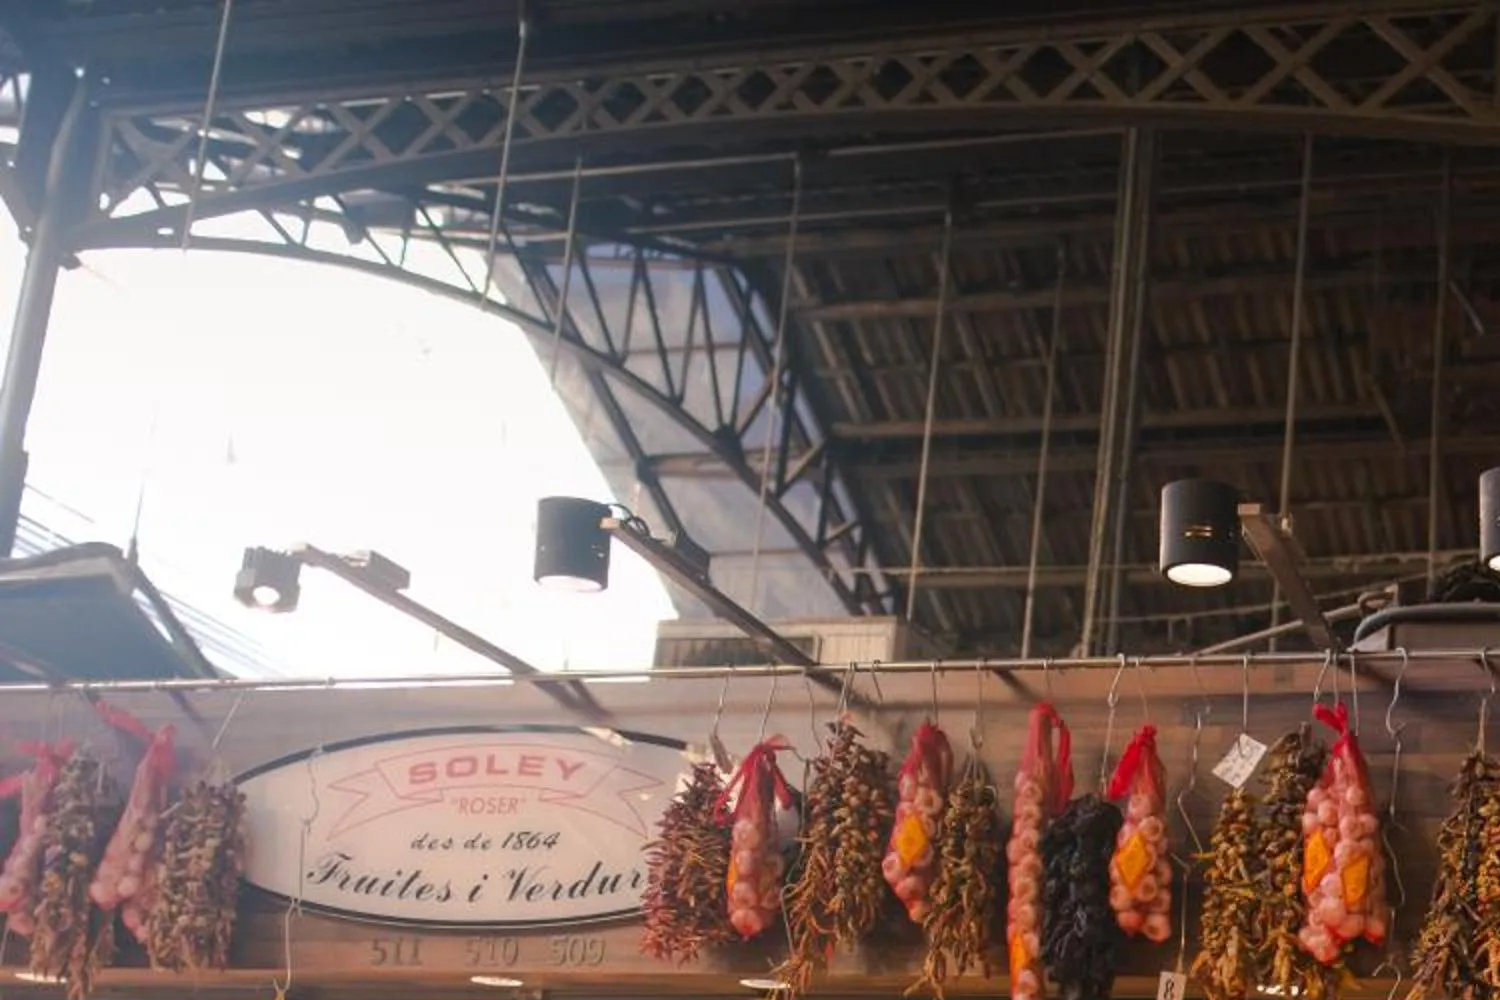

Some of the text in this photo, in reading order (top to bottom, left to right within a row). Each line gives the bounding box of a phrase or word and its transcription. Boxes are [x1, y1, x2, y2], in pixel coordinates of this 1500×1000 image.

[408, 753, 587, 785] SOLEY
[410, 831, 561, 851] des de 1864
[306, 851, 643, 903] Fruites i Verdur
[369, 936, 425, 967] 511
[465, 936, 519, 967] 510
